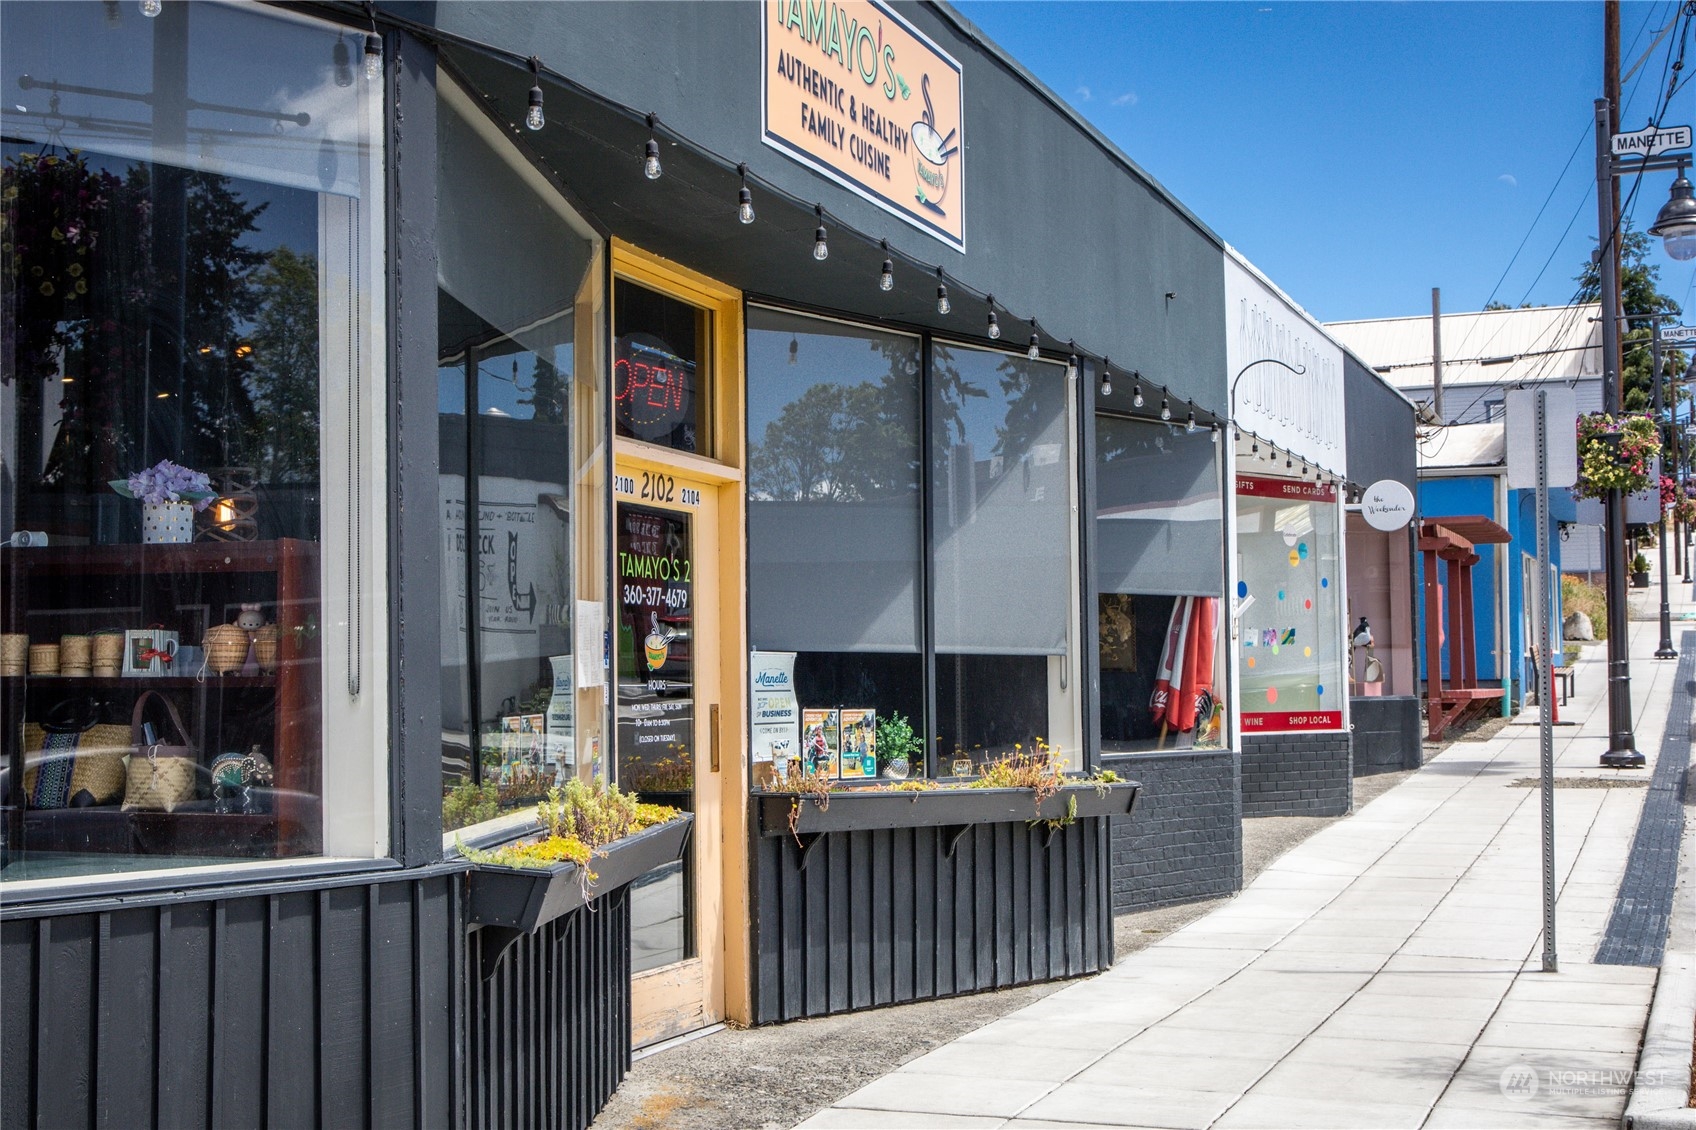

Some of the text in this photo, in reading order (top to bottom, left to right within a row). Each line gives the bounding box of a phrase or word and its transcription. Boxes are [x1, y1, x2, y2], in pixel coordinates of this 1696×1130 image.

[777, 48, 909, 154] AUTHENTIC & HEALTHY
[801, 102, 891, 181] FAMILY CUISINE
[1617, 131, 1685, 150] MANETTE
[614, 359, 684, 410] OPEN
[615, 471, 700, 505] 2100 2102 2104
[1282, 484, 1300, 494] SEND
[1302, 486, 1325, 496] CARDS
[1373, 495, 1384, 503] the
[619, 552, 690, 582] TAMAYO'S 2
[623, 584, 687, 608] 360-377-4679
[648, 680, 667, 690] HOURS
[755, 671, 789, 687] Manette
[762, 709, 792, 718] BUSINESS
[1244, 715, 1331, 726] WINE SHOP LOCAL
